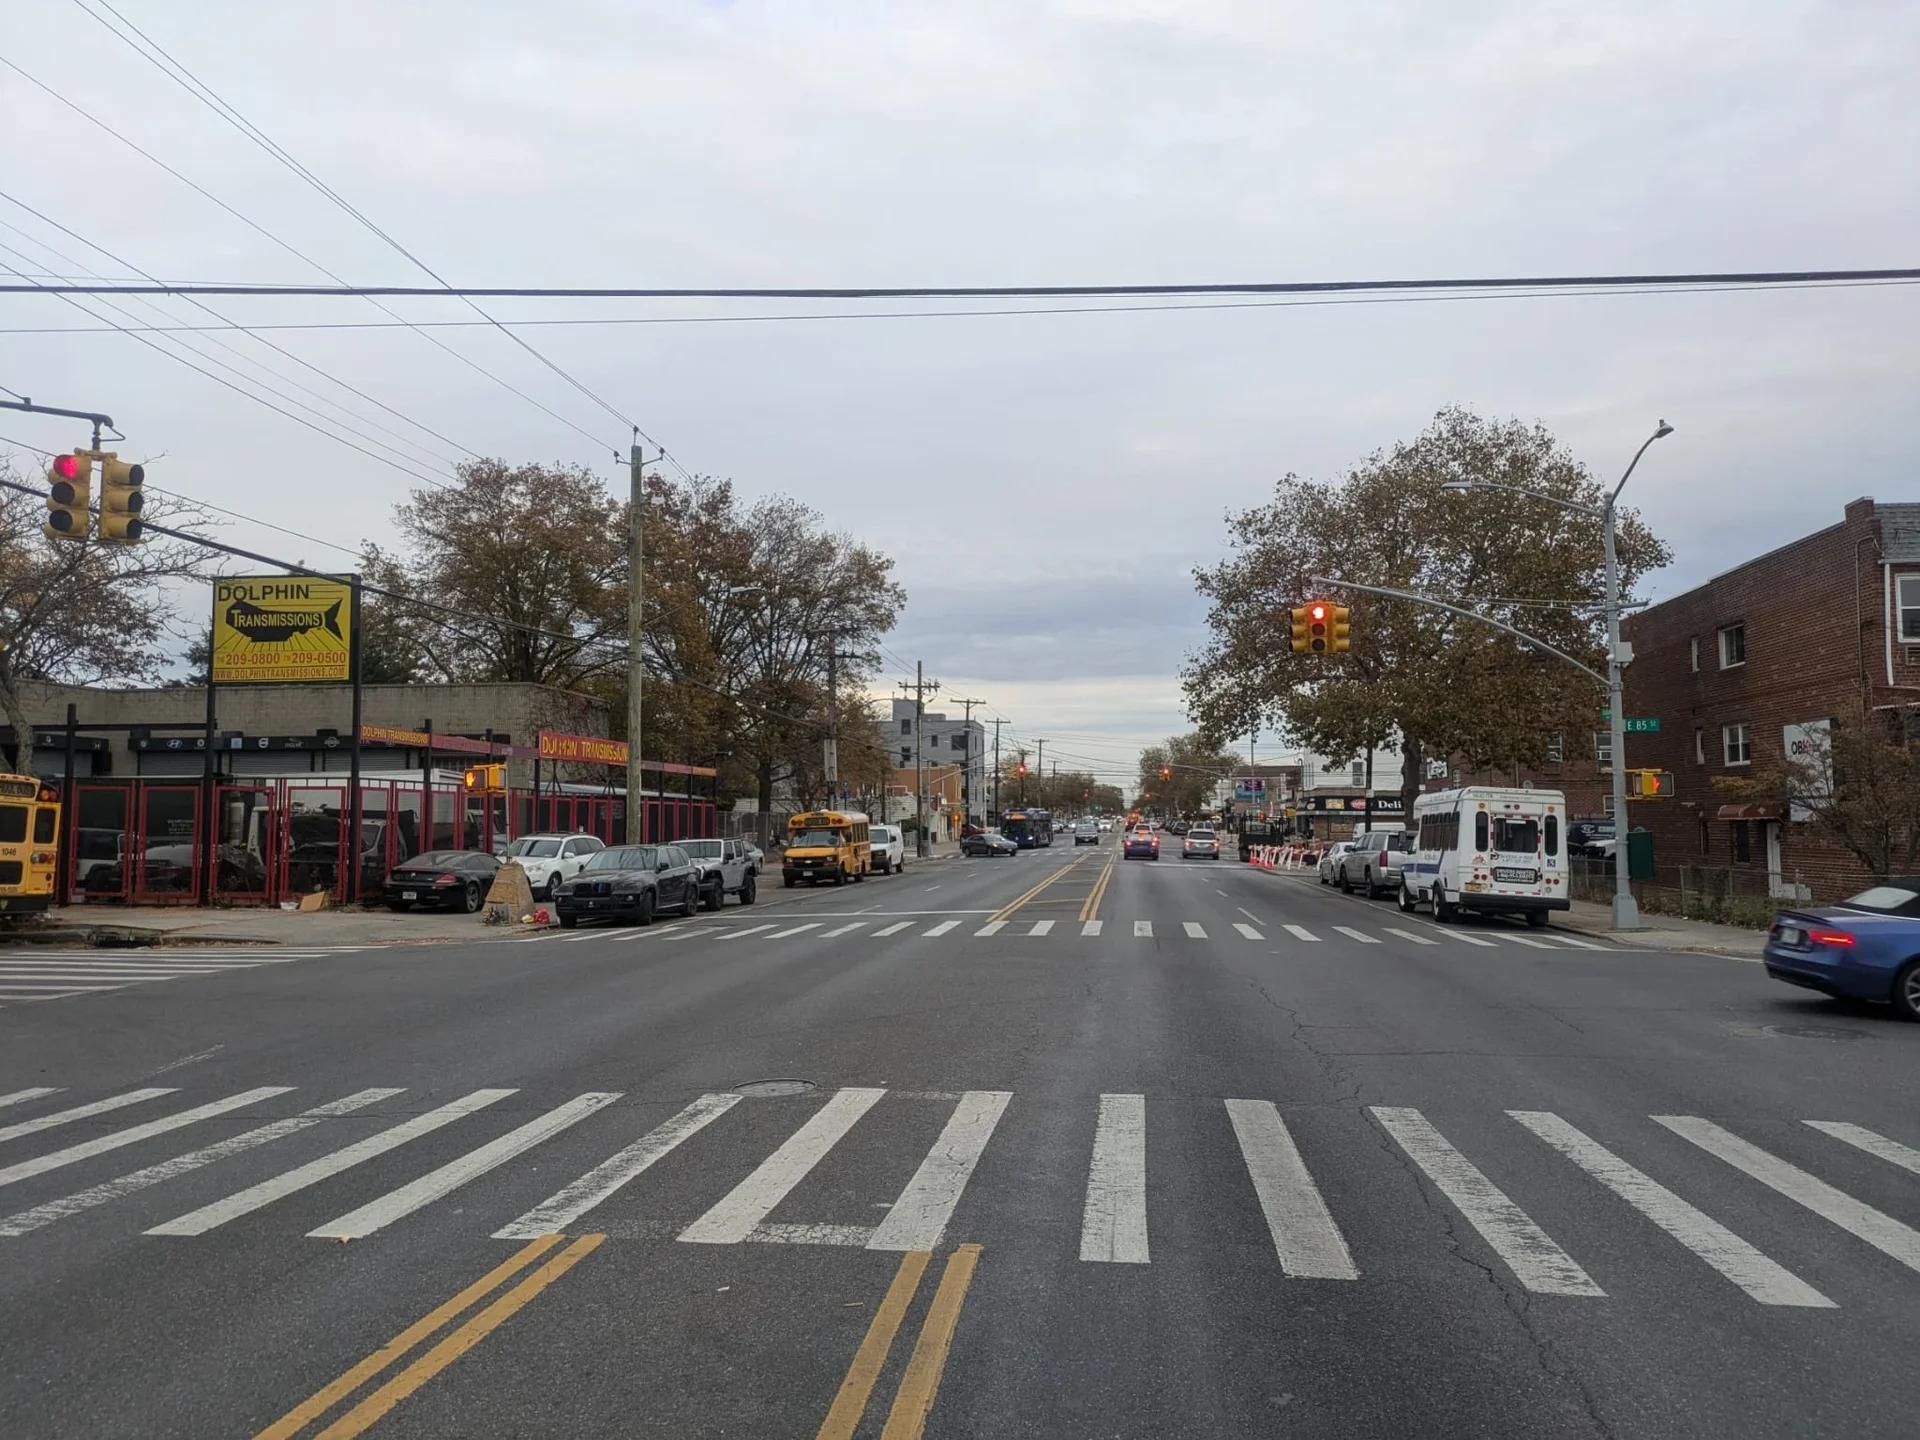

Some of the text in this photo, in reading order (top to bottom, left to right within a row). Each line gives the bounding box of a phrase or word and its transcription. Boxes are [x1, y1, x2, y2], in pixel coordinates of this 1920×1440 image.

[218, 584, 310, 602] DOLPHIN
[231, 610, 320, 627] TRANSMISSIONS
[225, 652, 280, 666] 209-0800
[291, 651, 346, 664] 209-0500
[215, 667, 345, 680] WWW.DOLPHINTRANSMISSIONS.COM
[1627, 720, 1633, 731] E
[1636, 720, 1648, 731] 85
[1377, 800, 1402, 809] Deli
[1, 847, 17, 857] 1046
